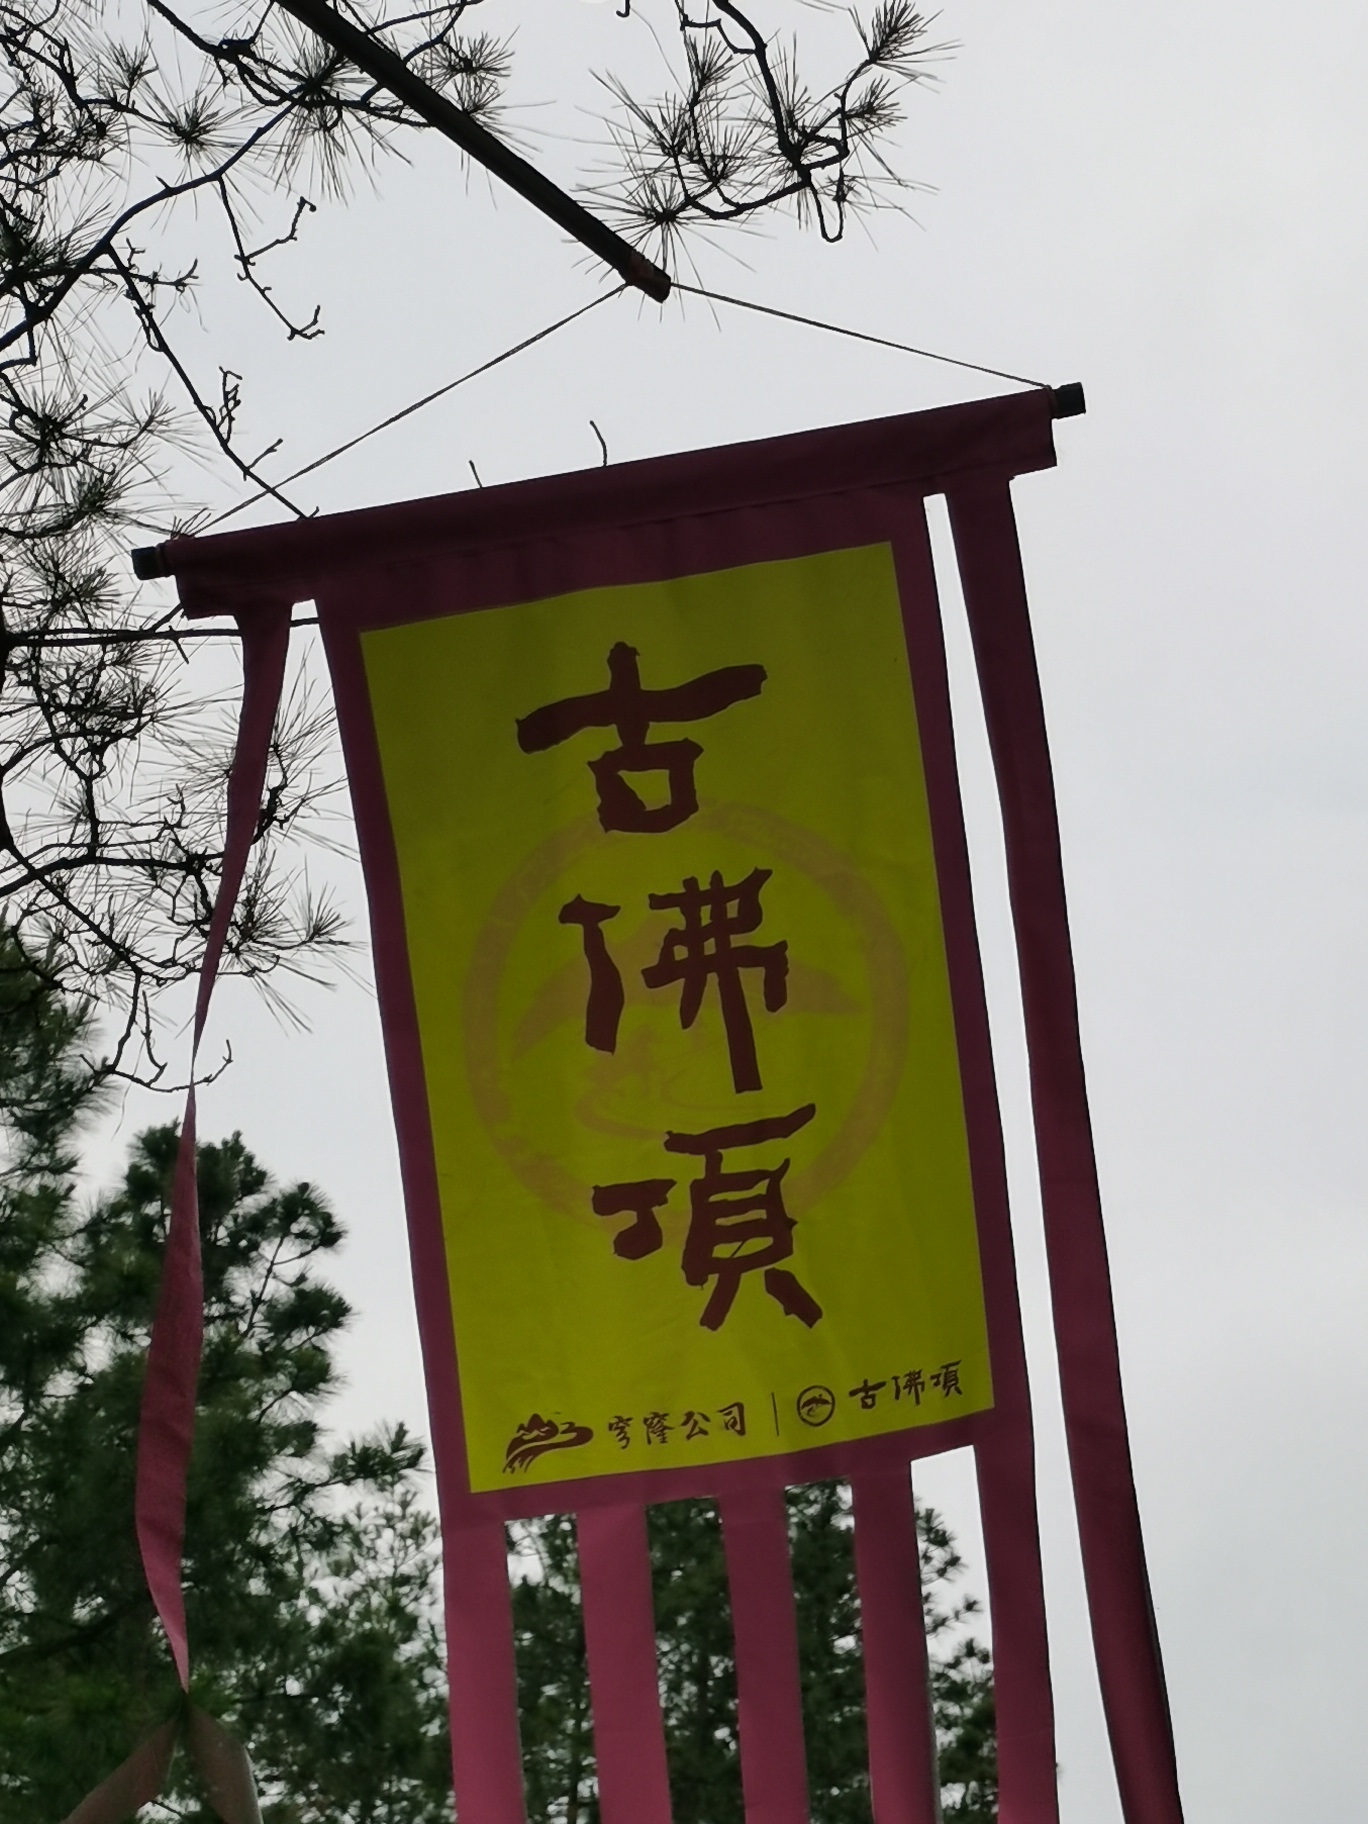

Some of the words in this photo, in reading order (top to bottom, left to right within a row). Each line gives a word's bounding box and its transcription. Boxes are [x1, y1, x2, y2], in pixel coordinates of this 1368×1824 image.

[515, 640, 823, 1331] 古佛頂
[848, 1359, 963, 1410] 古佛頂
